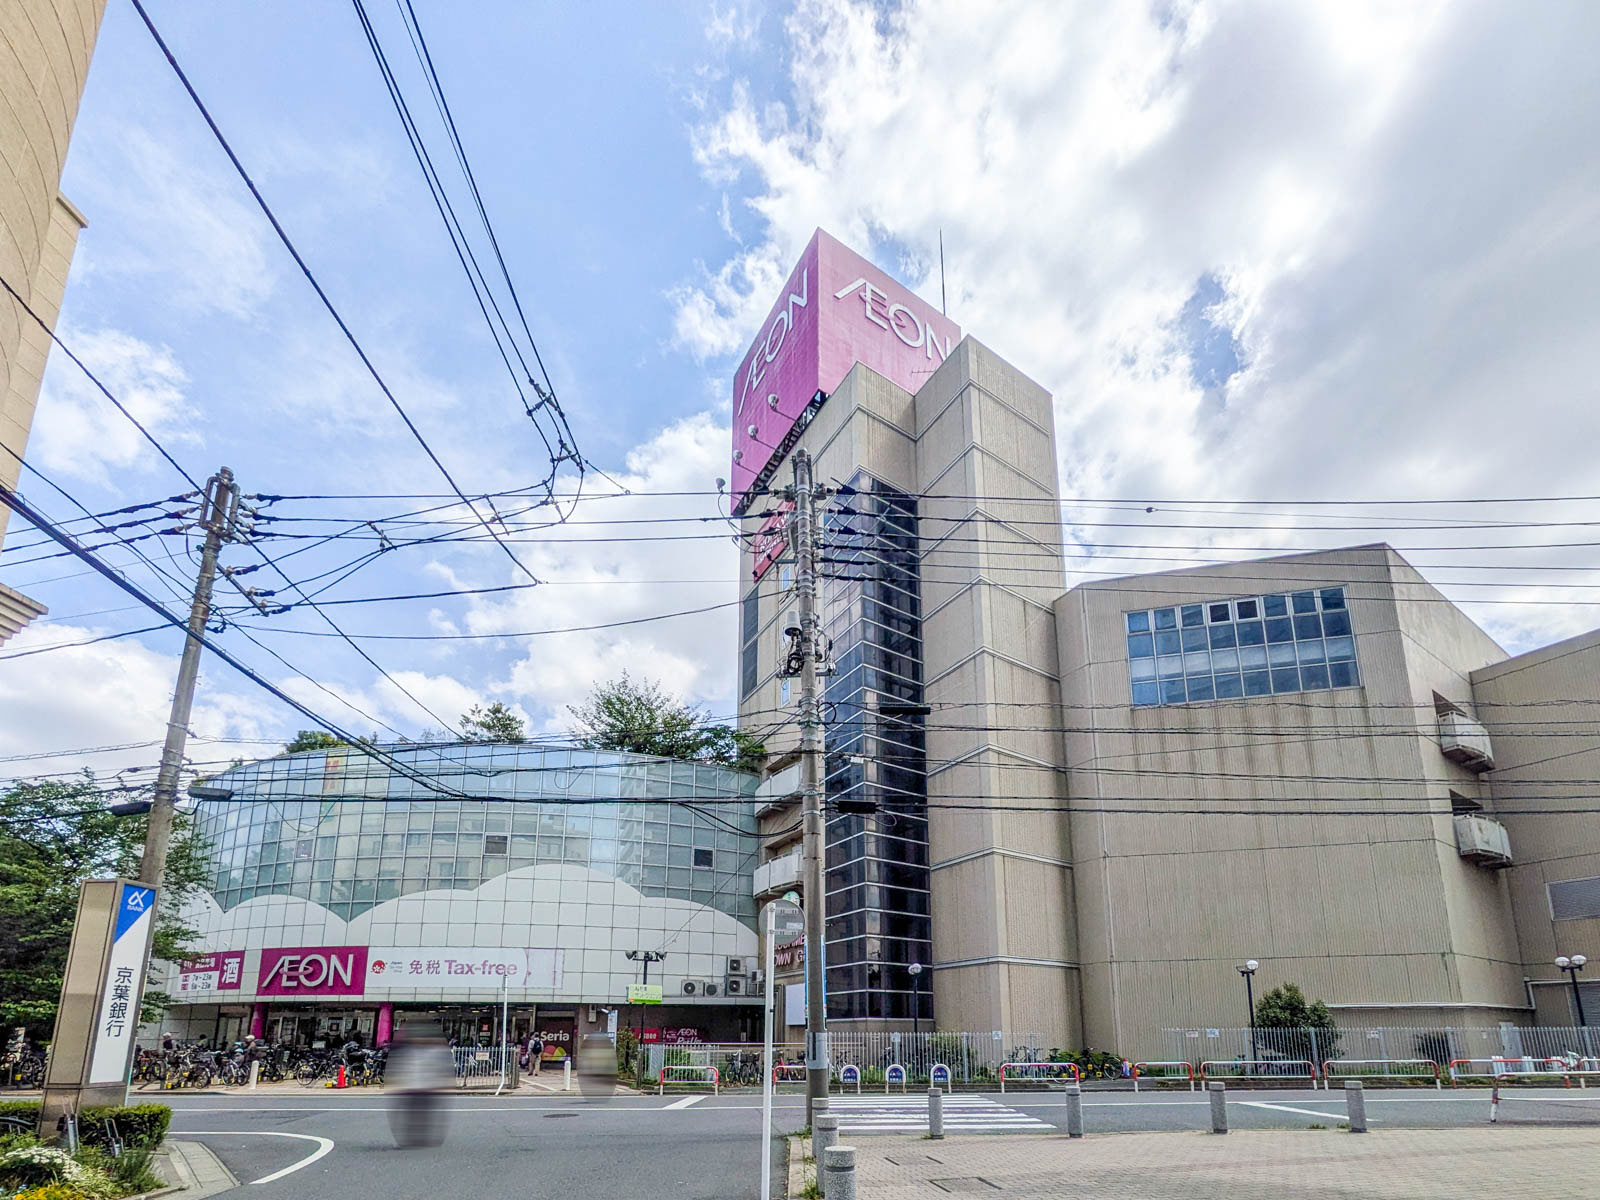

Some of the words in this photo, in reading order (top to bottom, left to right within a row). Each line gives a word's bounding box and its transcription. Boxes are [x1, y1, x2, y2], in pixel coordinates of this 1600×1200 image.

[221, 957, 241, 984] 酒
[408, 960, 441, 975] 免税
[444, 960, 518, 975] Tax-free
[105, 966, 134, 1038] 京葉銀行
[541, 1030, 570, 1041] Seria
